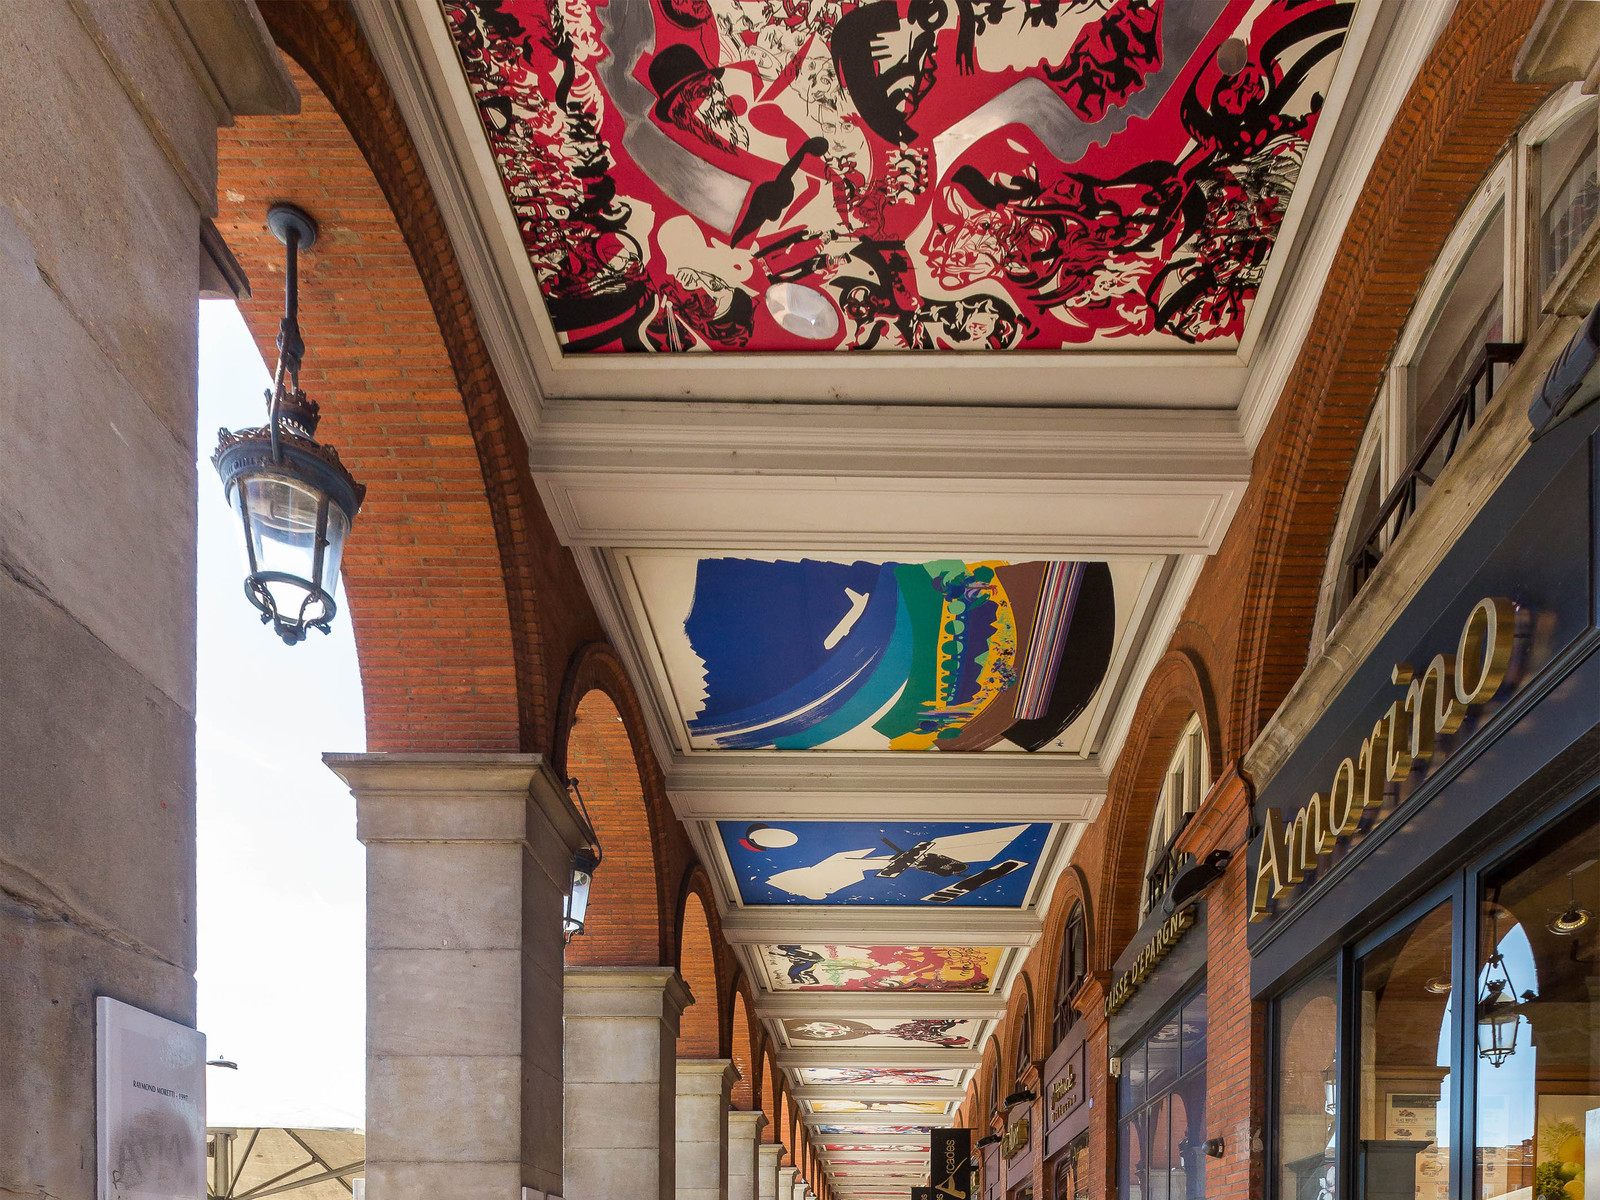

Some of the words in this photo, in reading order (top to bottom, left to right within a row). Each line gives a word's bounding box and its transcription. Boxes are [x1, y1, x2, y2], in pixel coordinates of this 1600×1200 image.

[1249, 597, 1508, 922] Amorino
[1104, 970, 1131, 1018] CAISSE
[133, 1079, 156, 1093] RAYMOND
[156, 1087, 175, 1098] MORETTI
[934, 1139, 967, 1200] Arcades
